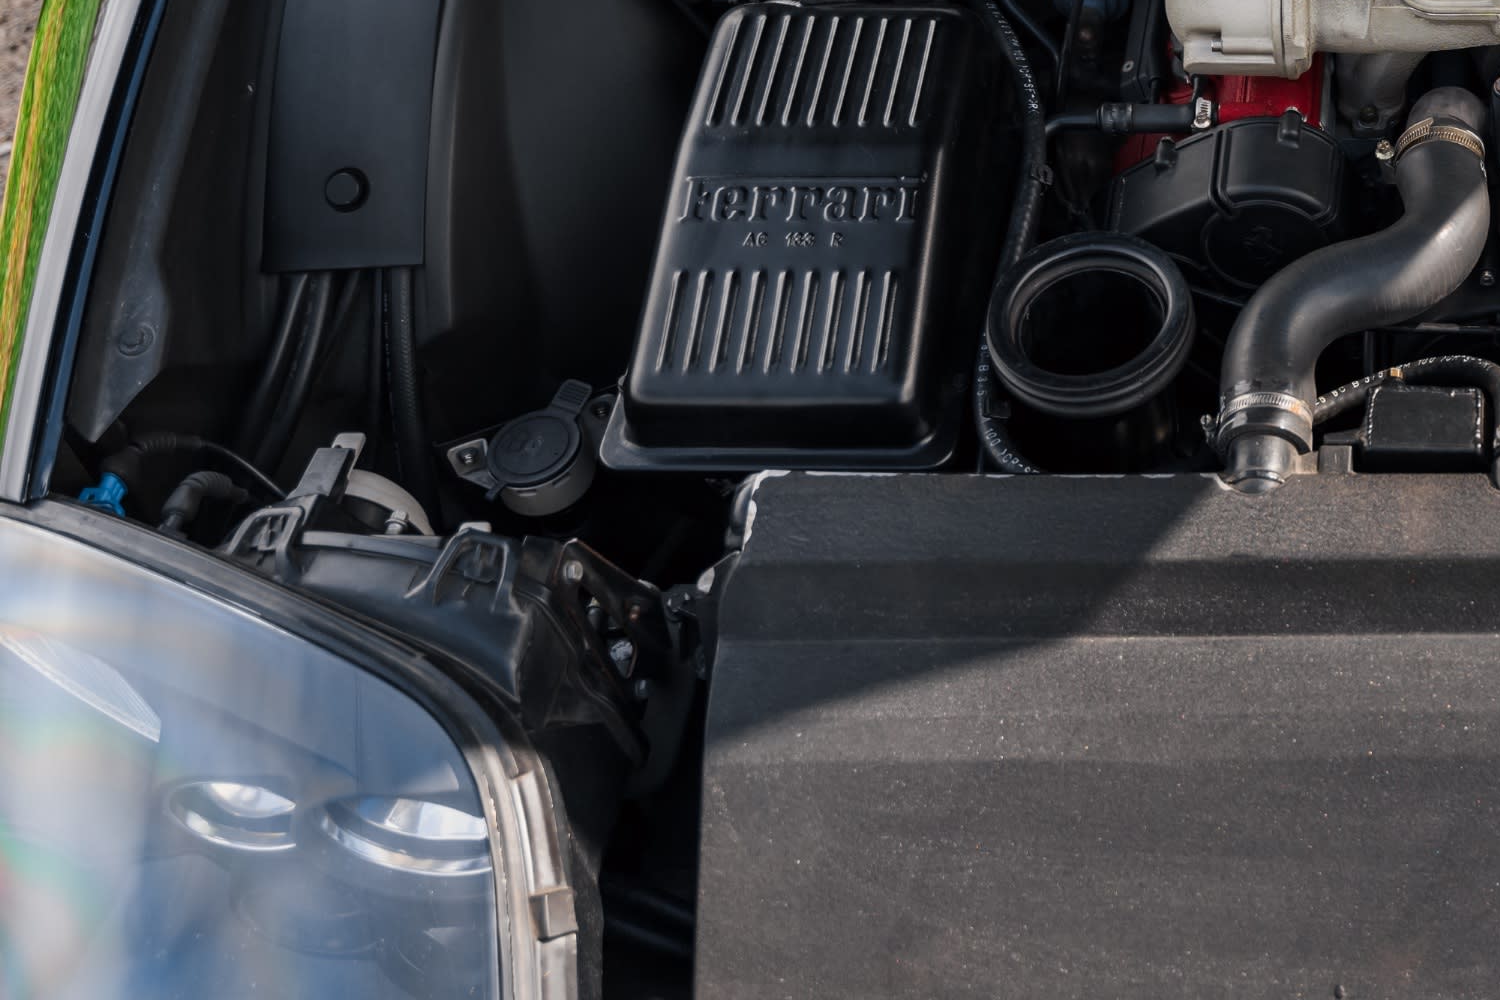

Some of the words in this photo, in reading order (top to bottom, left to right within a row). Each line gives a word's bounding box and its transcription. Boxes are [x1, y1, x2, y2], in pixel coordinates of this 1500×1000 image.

[677, 174, 925, 223] Ferrari
[742, 231, 768, 247] AC
[830, 231, 843, 247] R
